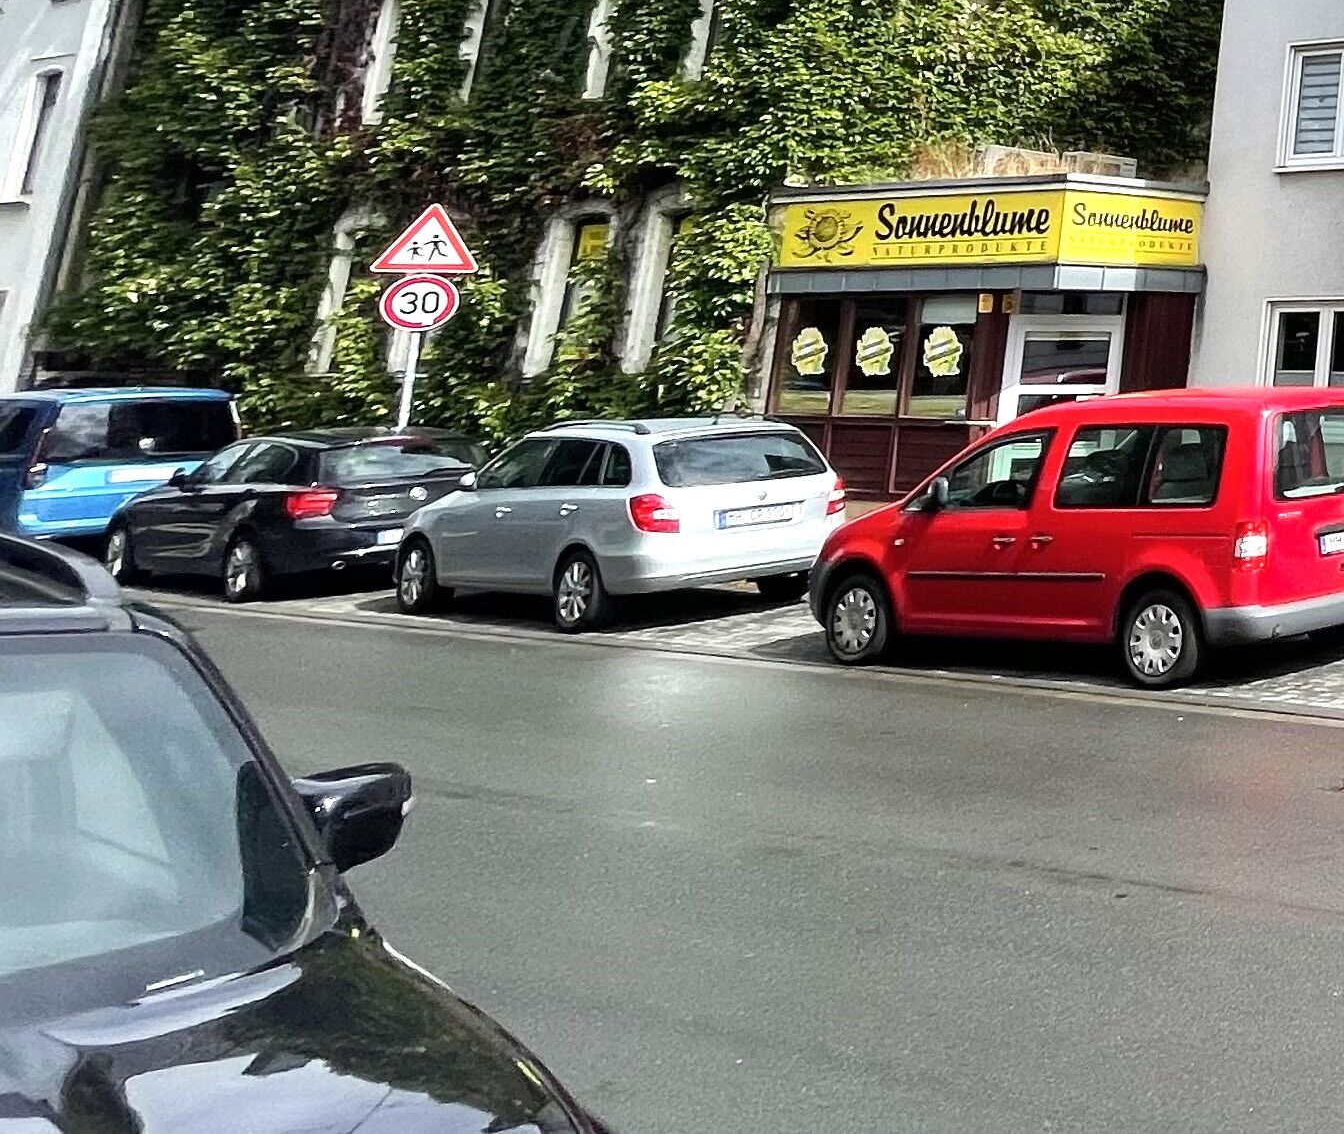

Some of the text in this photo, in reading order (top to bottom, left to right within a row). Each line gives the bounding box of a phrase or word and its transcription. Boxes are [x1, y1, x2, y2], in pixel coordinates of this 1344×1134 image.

[873, 198, 1050, 241] Sonnenblume
[1072, 202, 1194, 234] Sonnenblume
[399, 291, 440, 315] 30
